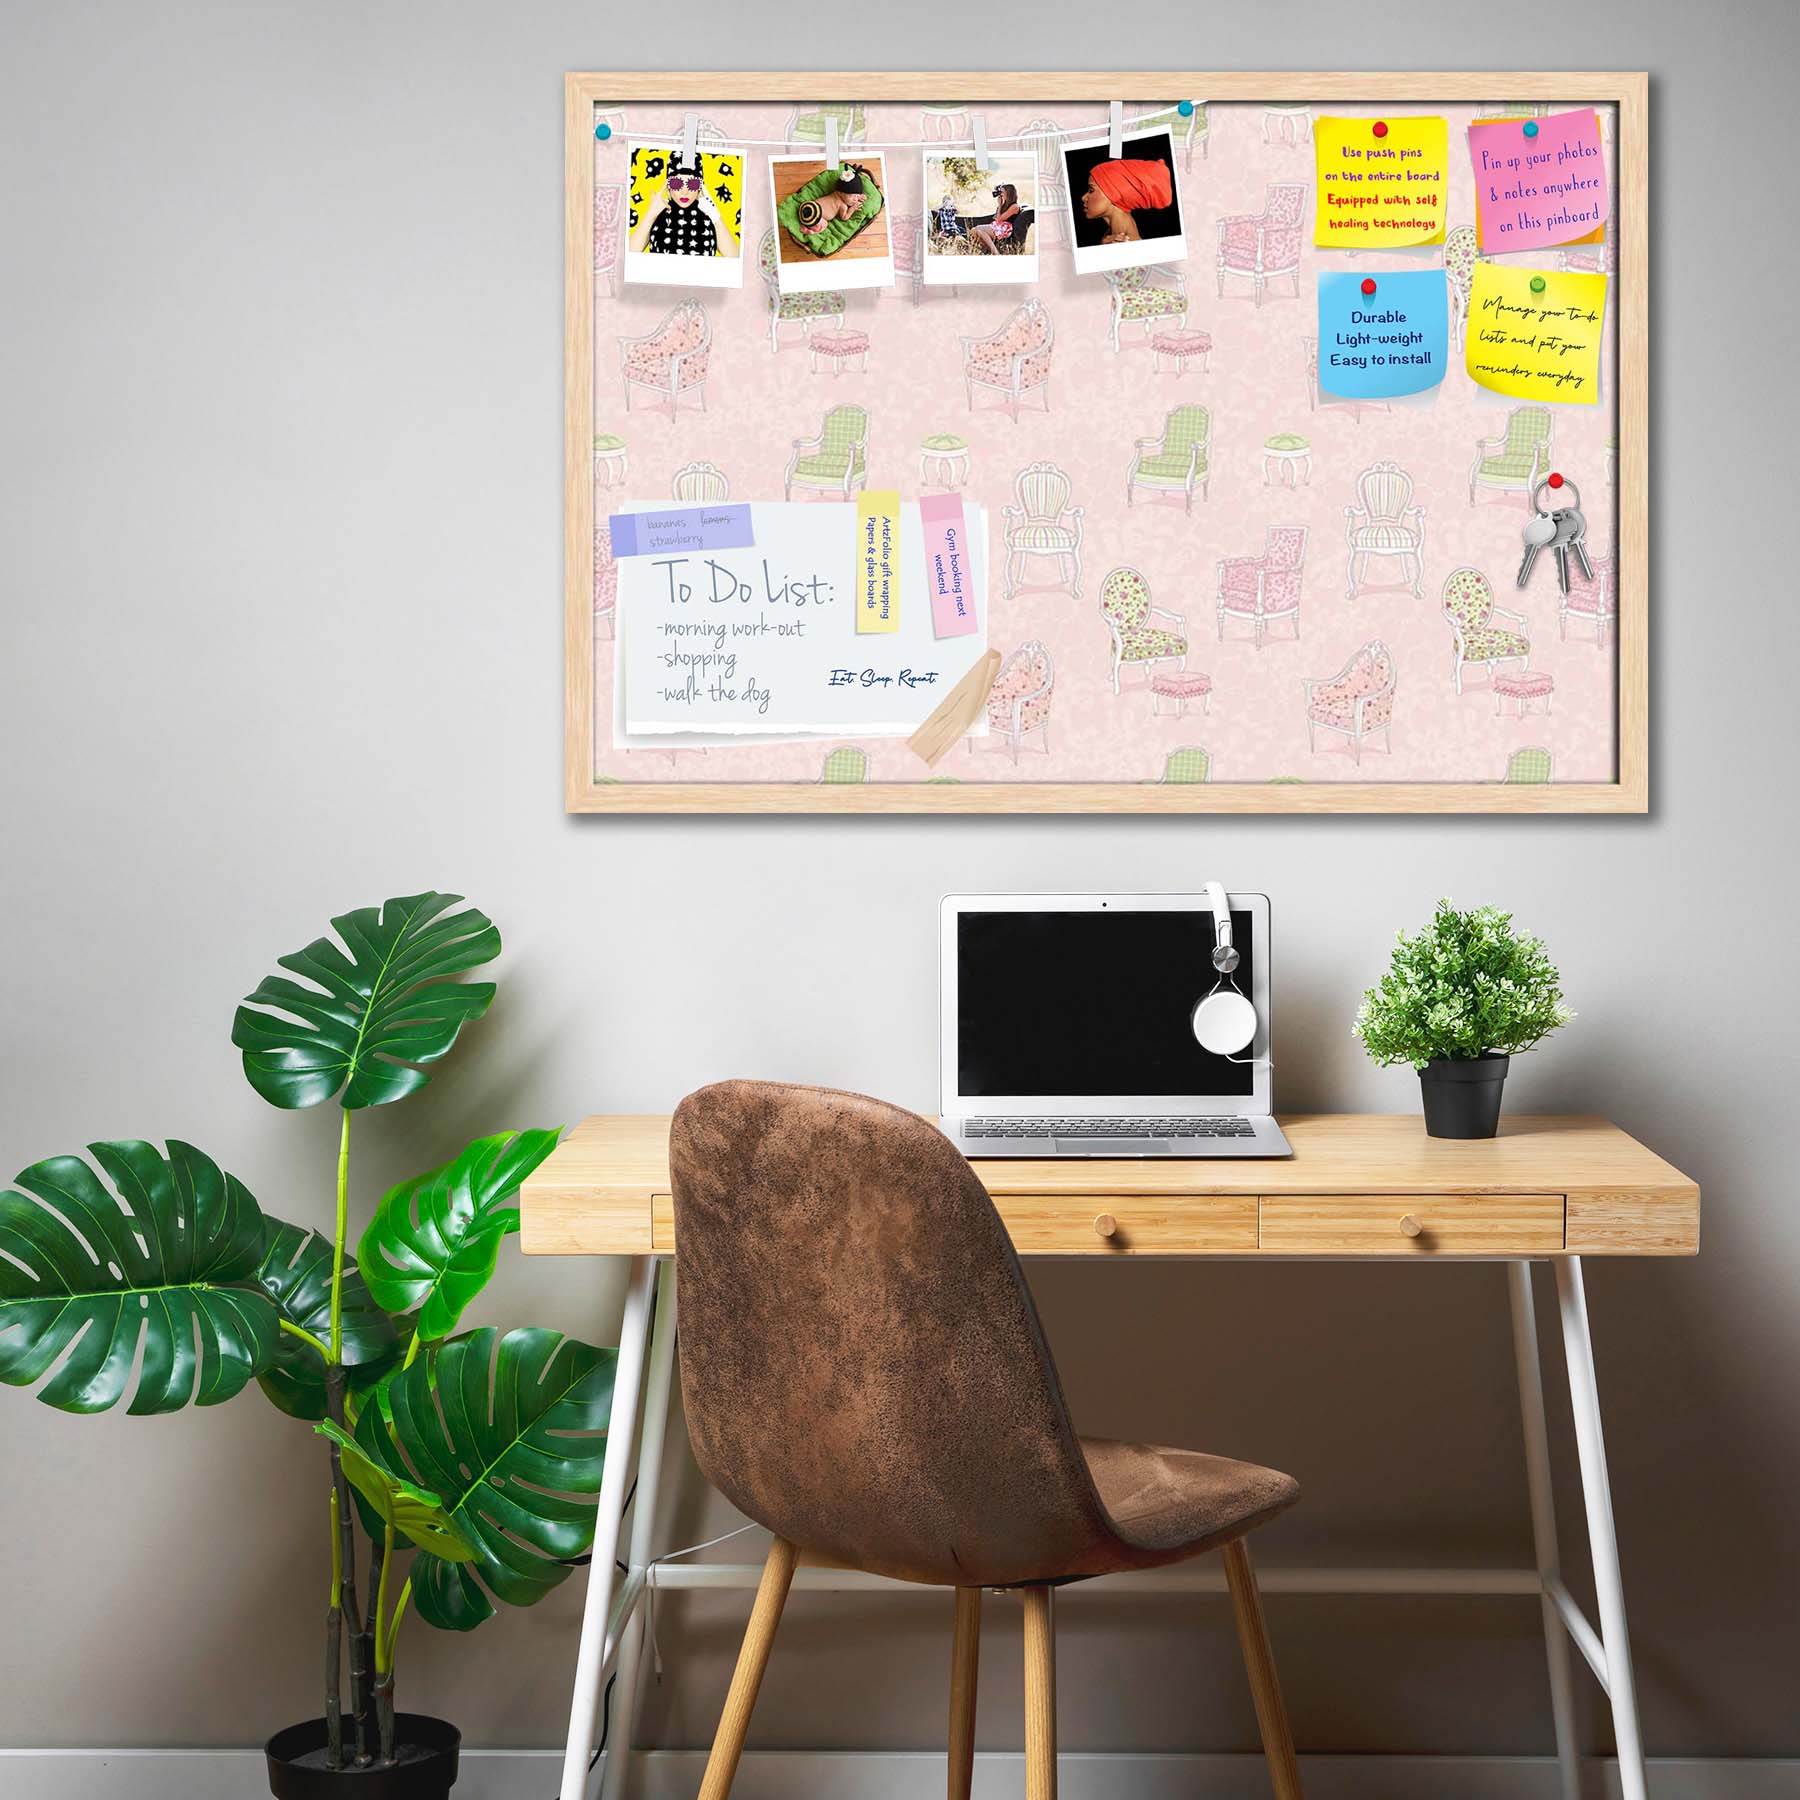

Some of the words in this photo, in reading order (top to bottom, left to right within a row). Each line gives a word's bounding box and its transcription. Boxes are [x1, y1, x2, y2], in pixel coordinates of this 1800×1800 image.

[1342, 146, 1362, 158] Use
[1366, 148, 1396, 161] push
[1400, 148, 1422, 161] pins
[1482, 150, 1502, 171] Pin
[1507, 158, 1520, 172] up
[1526, 153, 1552, 170] your
[1558, 140, 1598, 165] photos
[1325, 173, 1338, 181] on
[1342, 171, 1363, 182] the
[1368, 172, 1402, 181] entire
[1406, 170, 1440, 181] board
[1490, 186, 1499, 202] &
[1504, 180, 1538, 200] notes
[1543, 173, 1599, 198] anywhere
[1327, 193, 1379, 208] Equipped
[1384, 194, 1410, 206] with
[1416, 194, 1438, 208] self
[1329, 218, 1369, 230] healing
[1373, 218, 1436, 231] technology
[1500, 222, 1513, 233] on
[1518, 211, 1542, 230] this
[1546, 202, 1600, 231] pinboard
[1351, 310, 1407, 324] Durable
[1482, 295, 1537, 320] Manage
[1538, 309, 1566, 322] your
[1336, 331, 1424, 348] Light-weight
[1511, 335, 1537, 348] and
[1537, 336, 1563, 353] put
[1560, 342, 1586, 356] your
[1330, 353, 1368, 369] Easy
[1371, 354, 1385, 366] to
[1388, 352, 1432, 366] install
[1475, 364, 1533, 378] reminders
[1536, 370, 1585, 390] everyday
[866, 517, 877, 545] Papers
[882, 516, 892, 560] ArtzFolio
[945, 528, 956, 552] Gym
[867, 546, 877, 555] &
[865, 557, 878, 578] glass
[880, 562, 893, 578] gift
[934, 554, 950, 595] weekend
[950, 554, 963, 594] booking
[651, 558, 692, 604] To
[704, 558, 752, 604] Do
[762, 558, 835, 607] List:
[867, 580, 877, 609] boards
[880, 580, 890, 620] wrapping
[956, 596, 967, 617] next
[732, 612, 807, 637] work-out
[708, 674, 738, 702] the
[740, 677, 772, 715] dog
